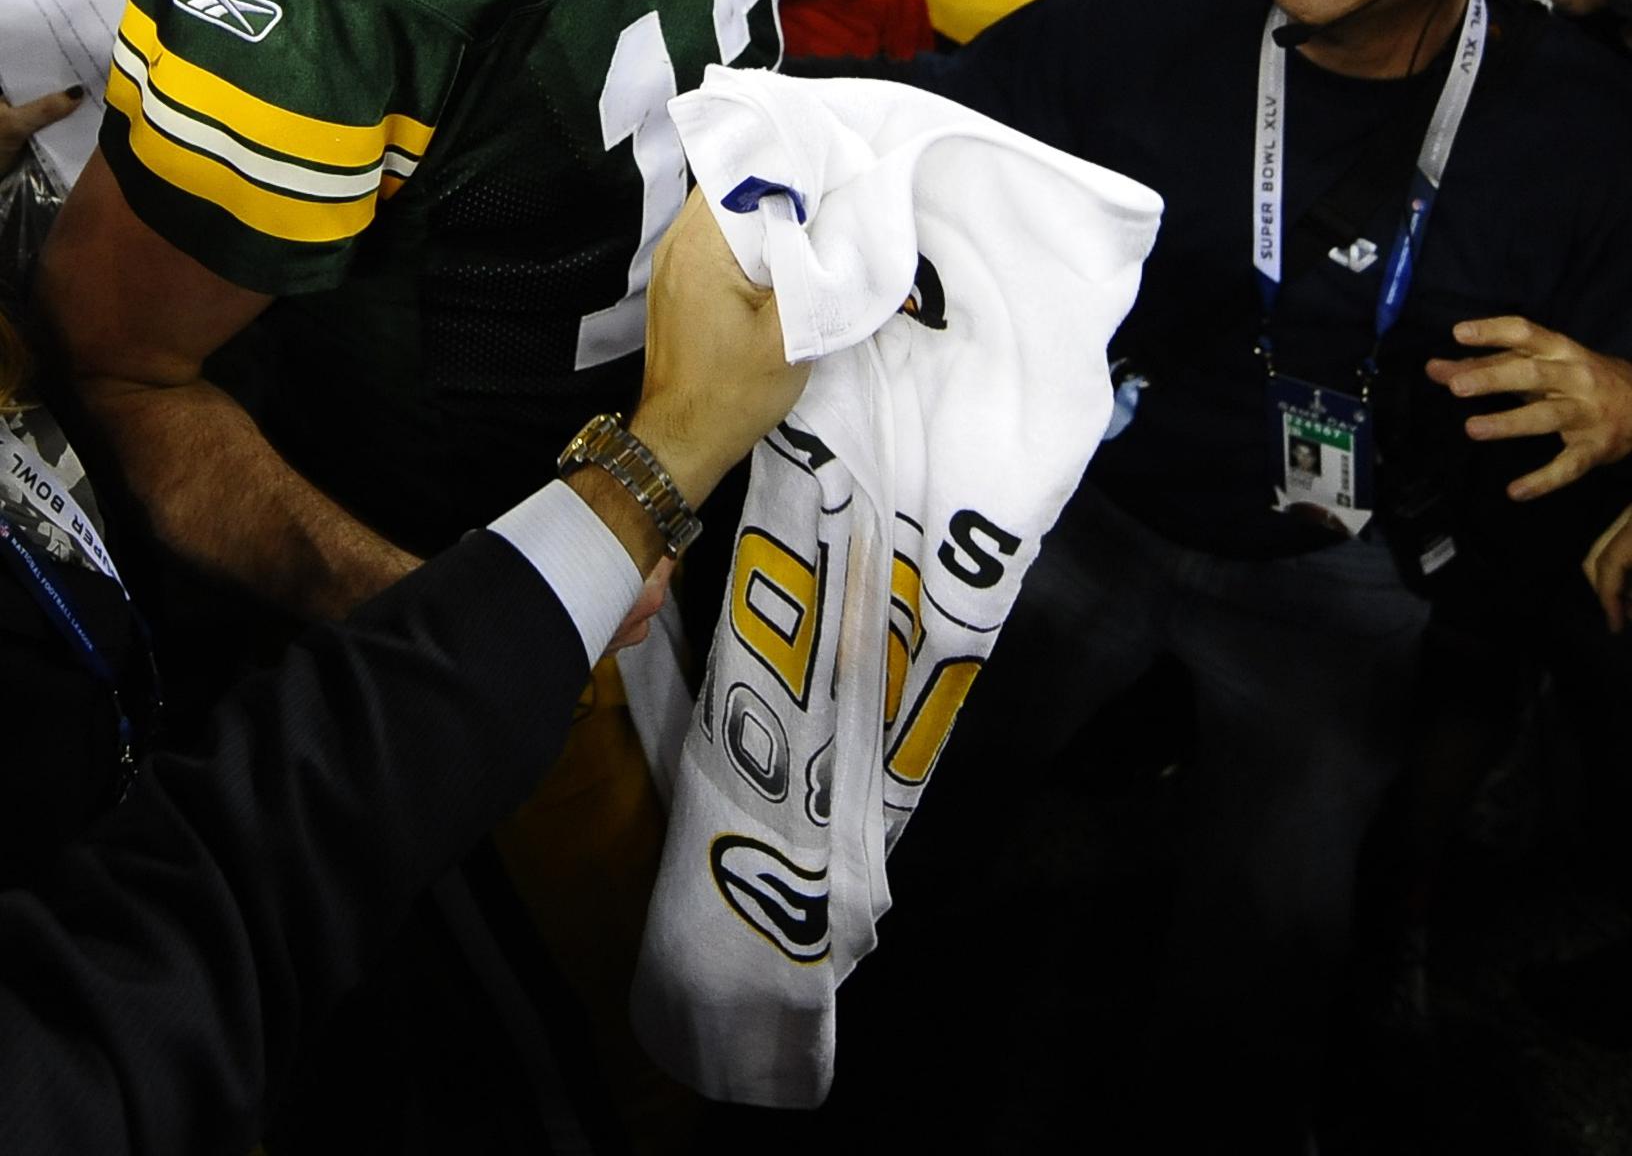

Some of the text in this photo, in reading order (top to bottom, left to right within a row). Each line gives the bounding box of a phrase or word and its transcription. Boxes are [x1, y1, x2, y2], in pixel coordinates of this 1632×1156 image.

[1459, 36, 1479, 75] XLV
[1260, 96, 1277, 260] SUPER BOWL XLV
[12, 453, 114, 576] UPER BOWL
[11, 537, 41, 579] NATIONAL
[40, 577, 72, 619] FOOTBALL
